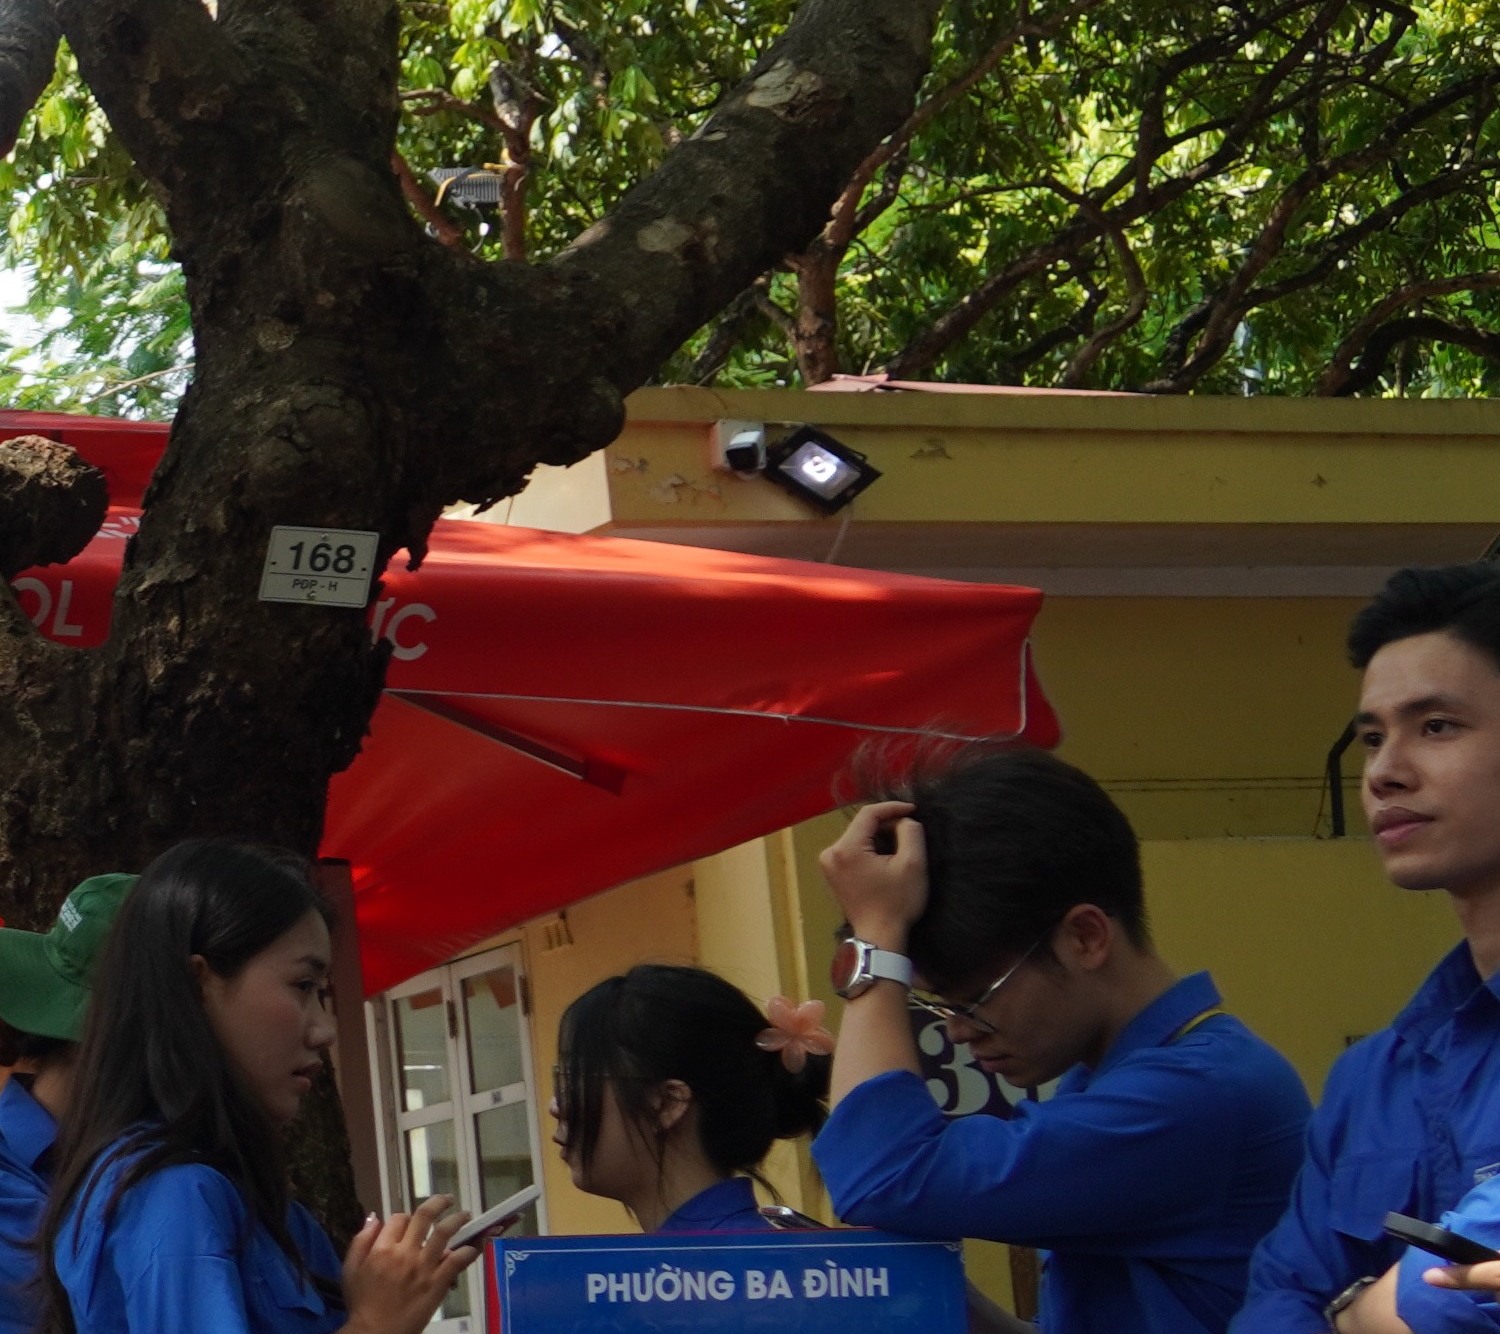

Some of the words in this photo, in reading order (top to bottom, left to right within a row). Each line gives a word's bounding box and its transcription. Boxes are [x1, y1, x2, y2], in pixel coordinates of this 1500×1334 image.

[288, 541, 357, 573] 168
[11, 576, 84, 636] OL
[588, 1263, 735, 1302] PHƯỜNG
[746, 1267, 793, 1300] BA
[803, 1261, 889, 1299] ĐÌNH
